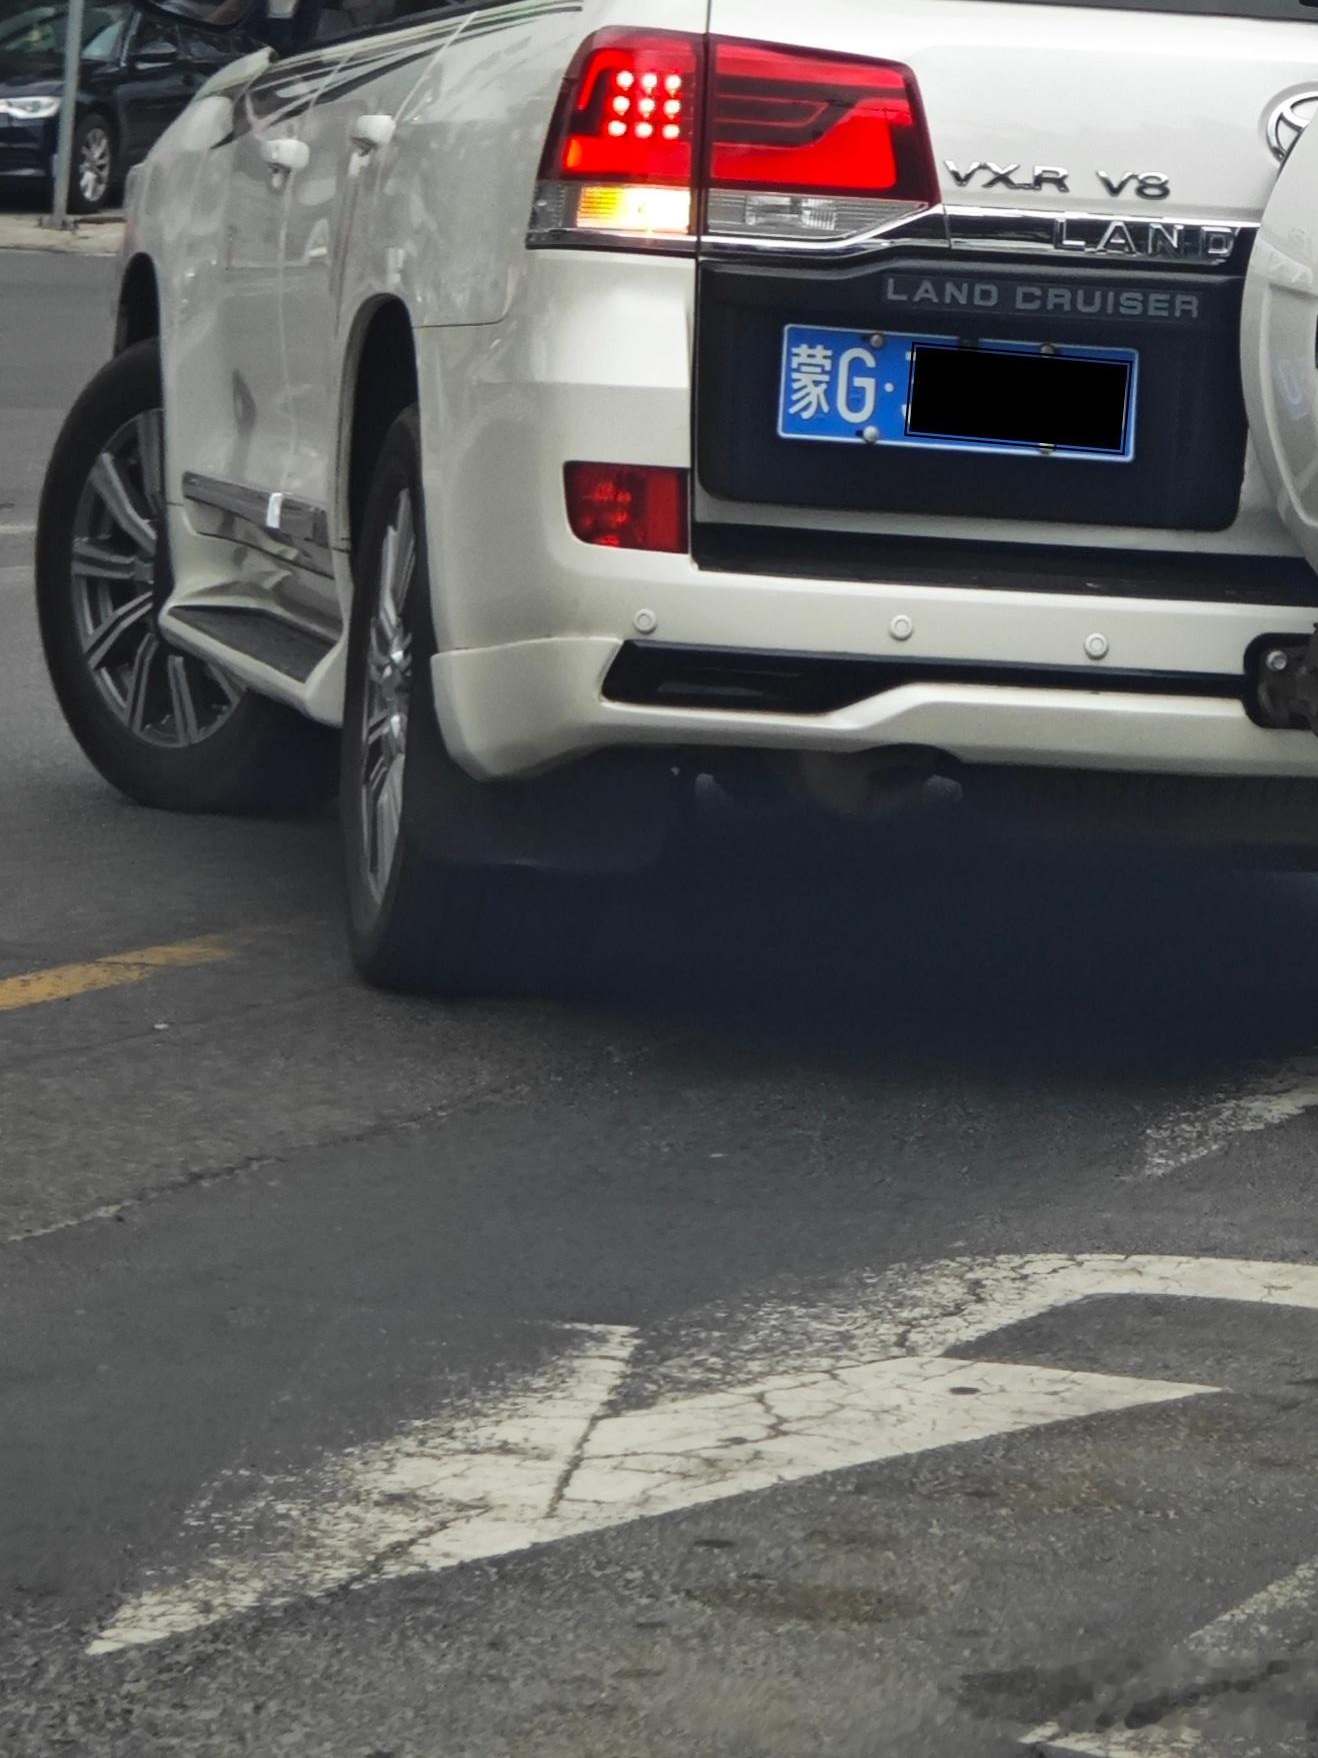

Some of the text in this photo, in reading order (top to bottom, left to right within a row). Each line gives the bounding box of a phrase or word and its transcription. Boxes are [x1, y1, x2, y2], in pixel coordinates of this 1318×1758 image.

[1096, 170, 1171, 201] V8
[886, 278, 1200, 319] LAND CRUISER
